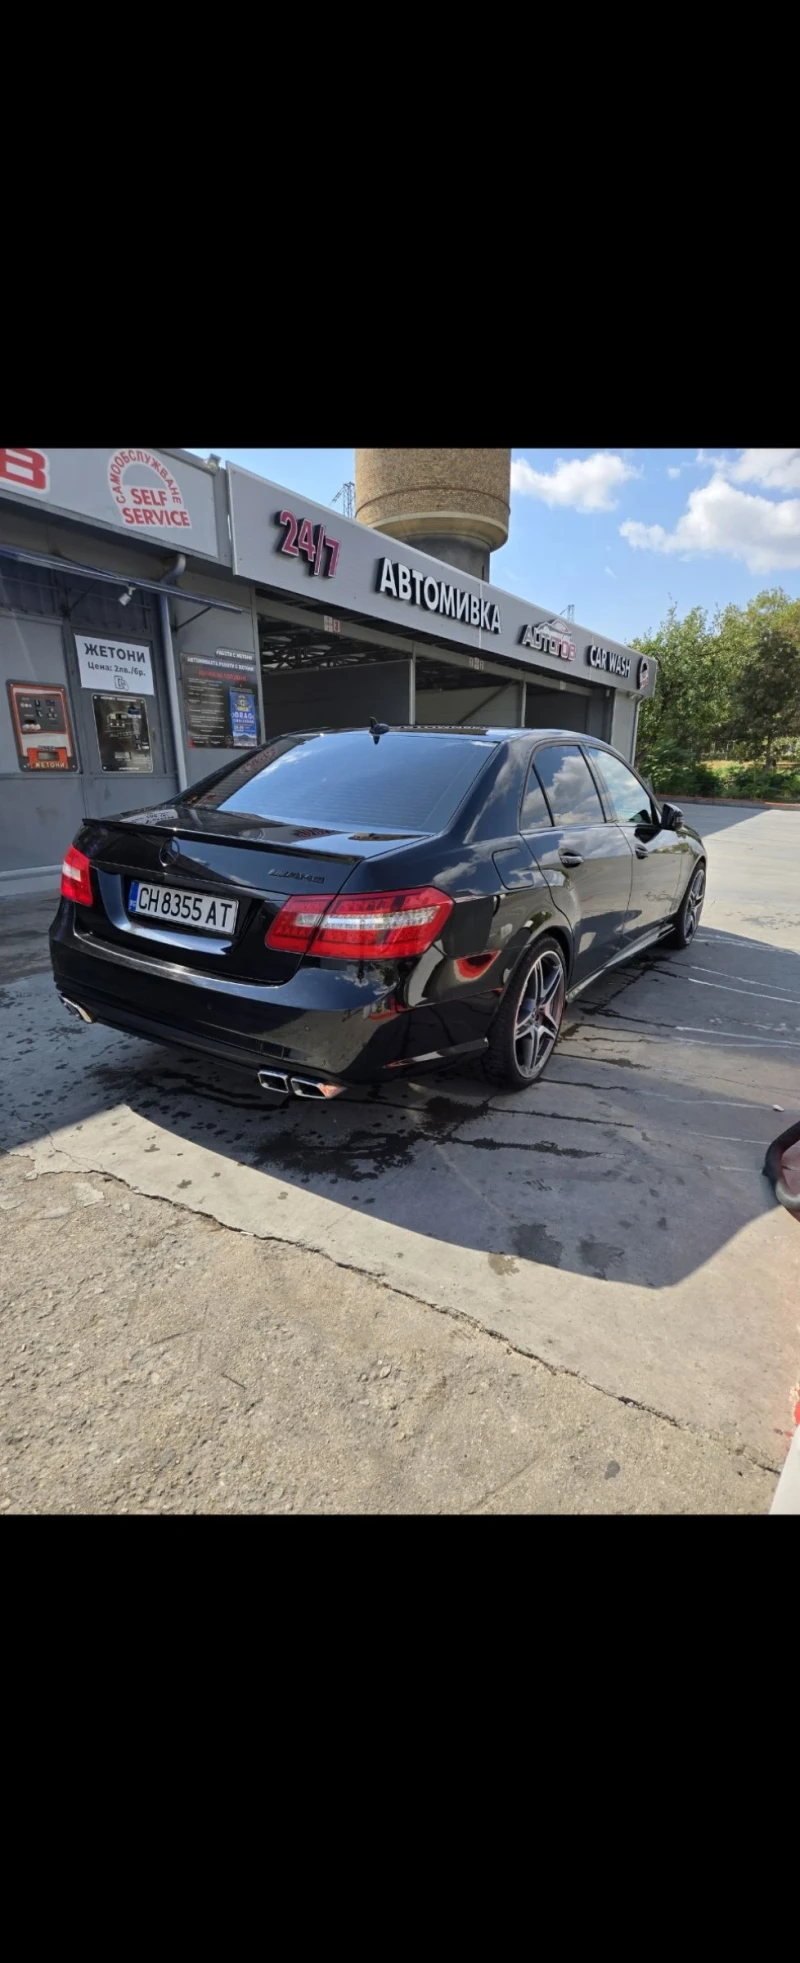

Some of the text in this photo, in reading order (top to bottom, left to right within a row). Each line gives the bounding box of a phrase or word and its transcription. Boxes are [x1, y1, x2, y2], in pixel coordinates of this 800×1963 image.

[110, 449, 182, 505] САМООБСЛУЖВАНЕ
[130, 488, 168, 507] SELF
[122, 508, 191, 527] SERVICE
[279, 509, 340, 578] 24/7
[379, 557, 501, 634] АВТОМИВКА
[84, 642, 146, 664] ЖЕТОНИ
[87, 661, 147, 677] Цена: 2лв./бр.
[589, 645, 632, 678] CAR WASH
[138, 887, 233, 928] CH 8355 AT
